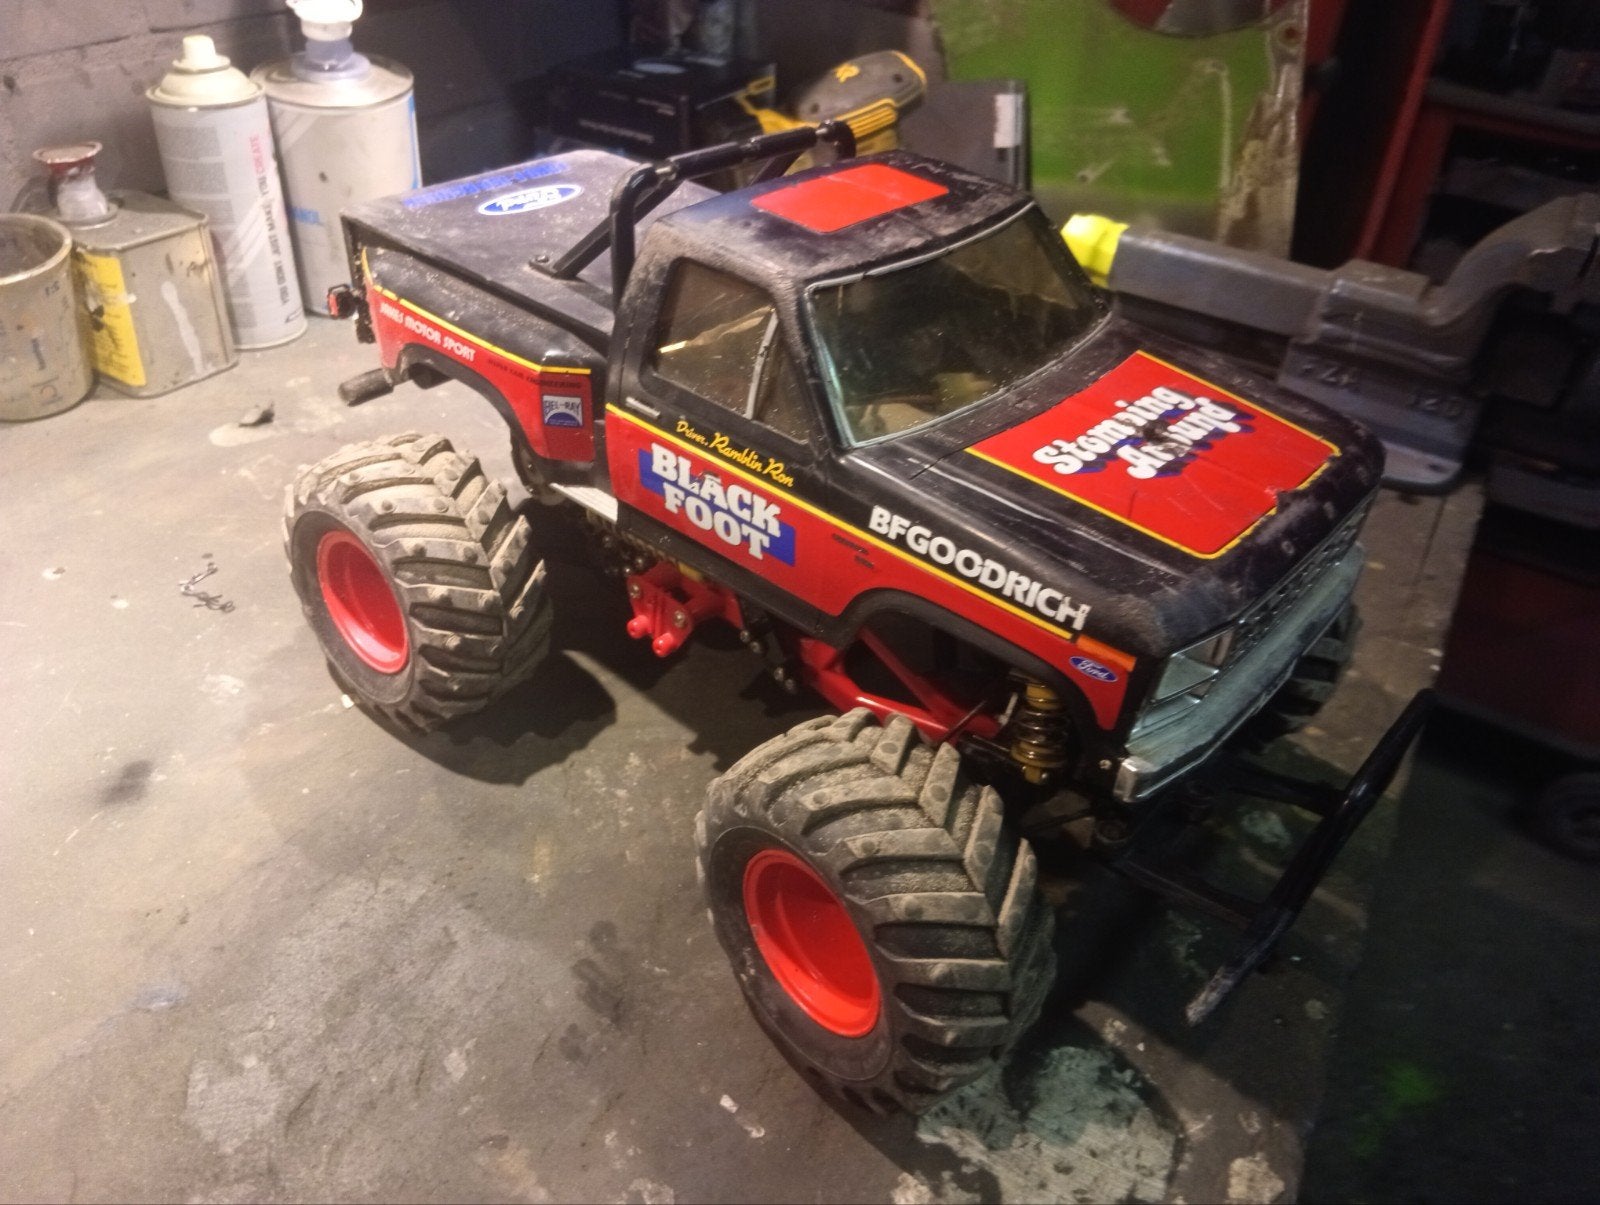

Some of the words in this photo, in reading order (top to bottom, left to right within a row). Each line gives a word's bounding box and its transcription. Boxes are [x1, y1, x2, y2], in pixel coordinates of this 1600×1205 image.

[404, 316, 442, 344] MOTOR
[443, 336, 476, 363] SPORT
[651, 442, 781, 538] BLACK
[708, 432, 763, 473] Ramblin
[762, 457, 795, 488] Ron
[662, 481, 770, 561] FOOT
[867, 504, 1092, 631] BFGOODRICH
[1074, 657, 1113, 682] Ford
